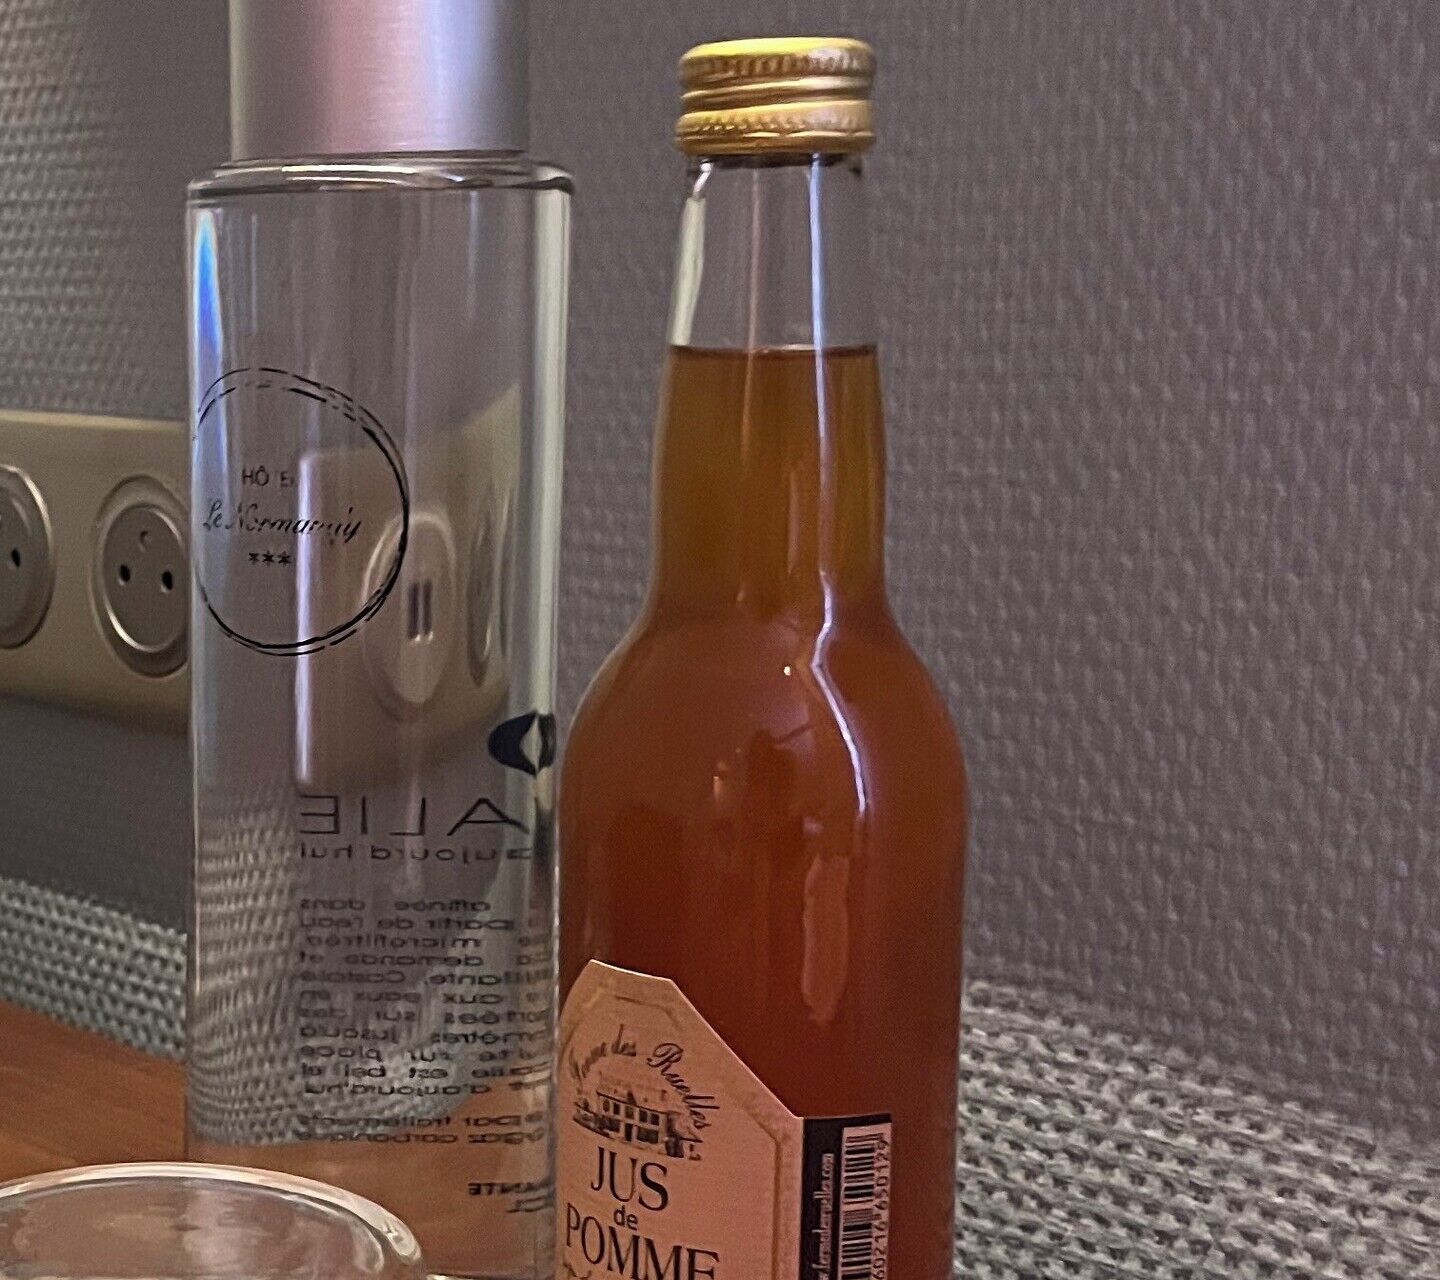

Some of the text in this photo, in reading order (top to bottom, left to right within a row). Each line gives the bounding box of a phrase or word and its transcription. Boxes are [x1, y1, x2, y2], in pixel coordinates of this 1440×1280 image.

[242, 465, 295, 487] HÔE
[591, 1146, 668, 1211] JUS
[614, 1205, 638, 1231] de
